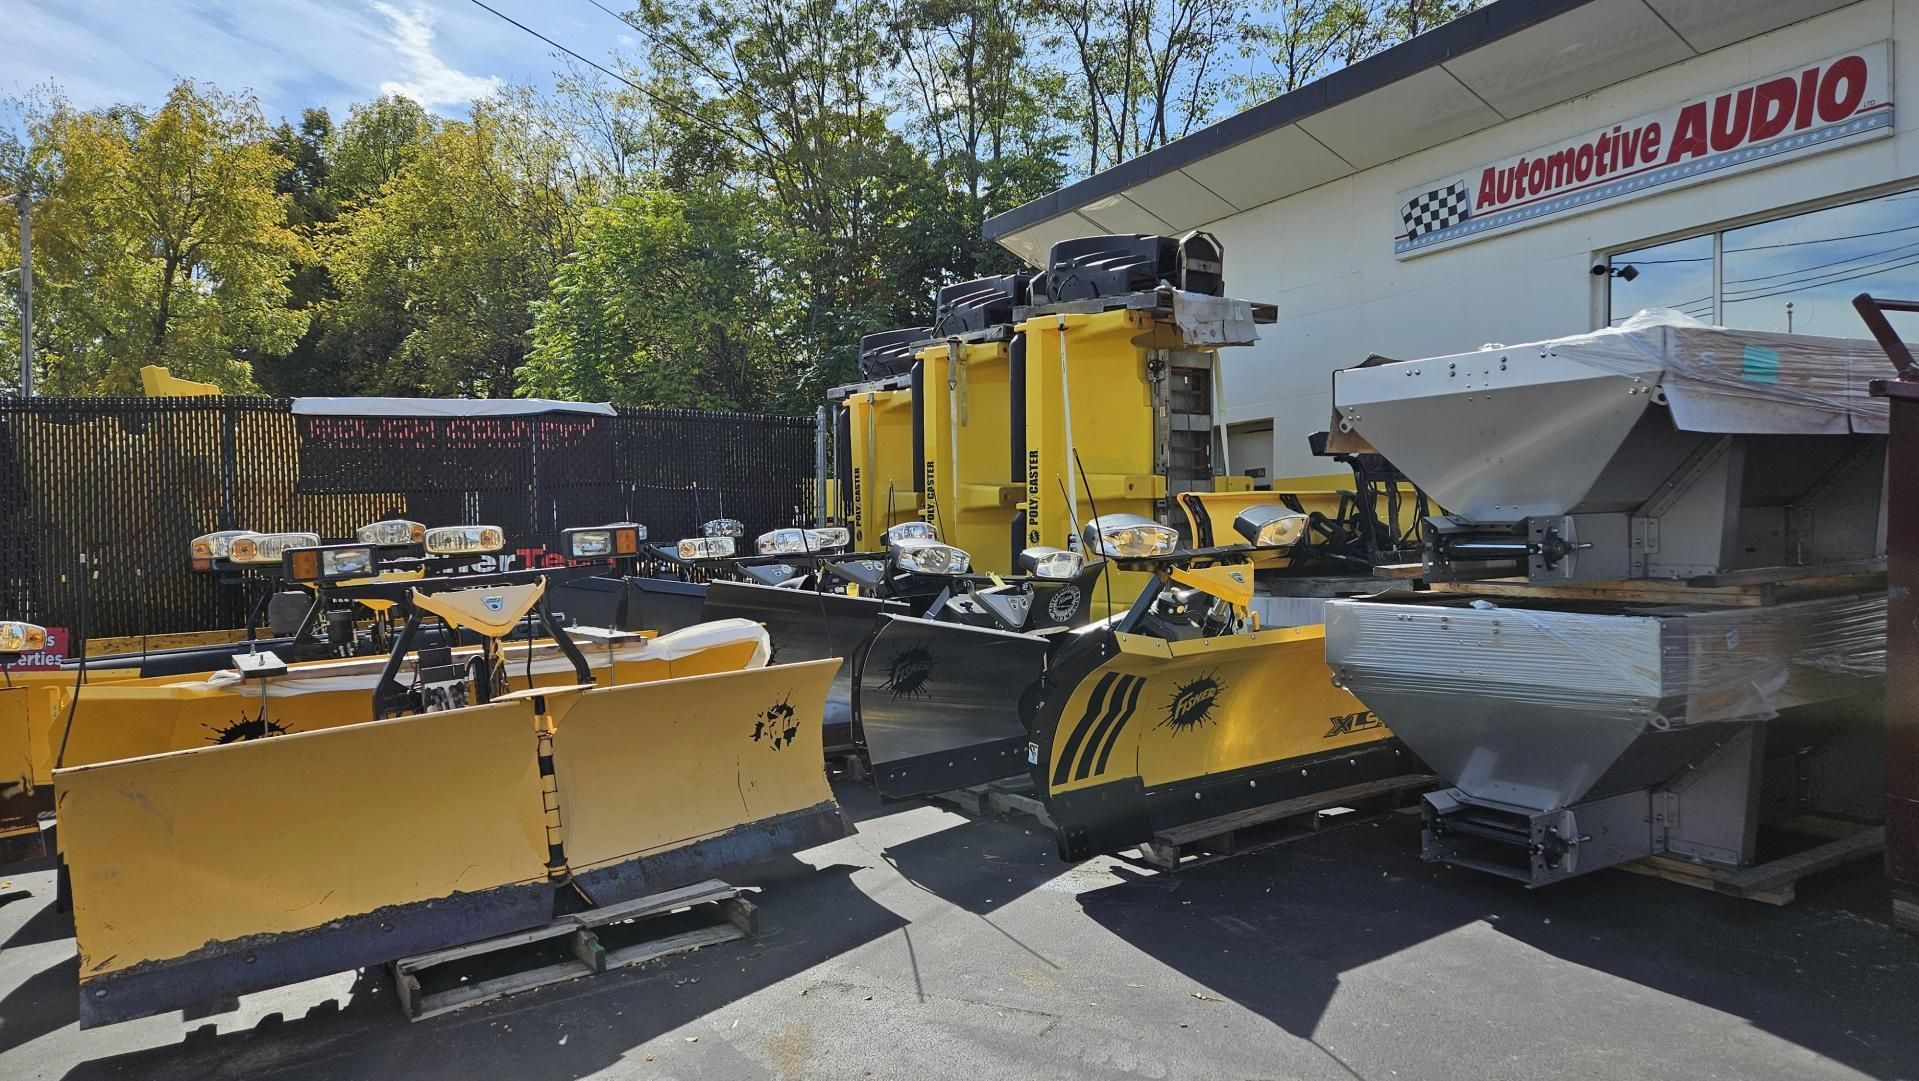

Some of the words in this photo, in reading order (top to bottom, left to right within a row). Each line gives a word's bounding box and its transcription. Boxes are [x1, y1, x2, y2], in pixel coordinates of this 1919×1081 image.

[1475, 122, 1661, 210] Automotive
[1664, 55, 1867, 164] AUDIO
[926, 461, 935, 500] CASTER
[1029, 450, 1039, 494] CASTER
[855, 505, 863, 527] POLY
[1029, 499, 1039, 526] POLY
[1174, 687, 1217, 720] FISHER
